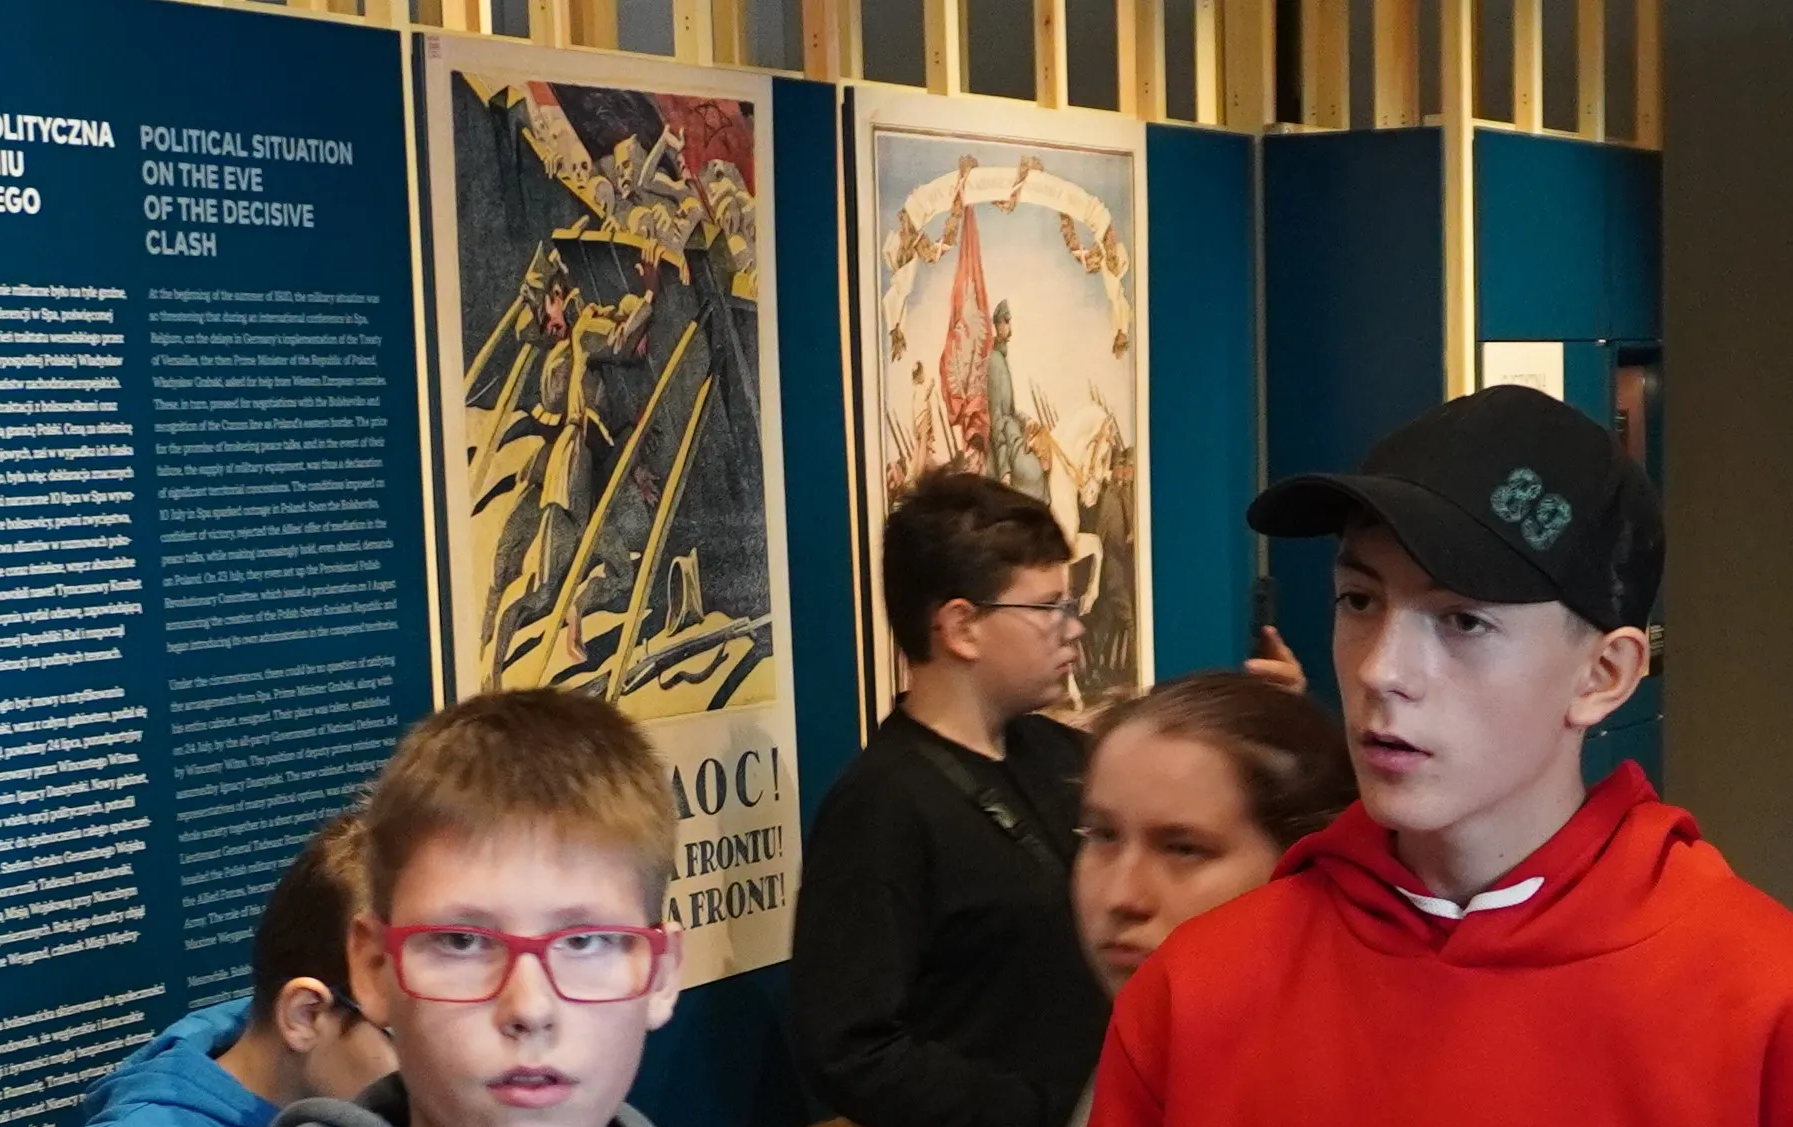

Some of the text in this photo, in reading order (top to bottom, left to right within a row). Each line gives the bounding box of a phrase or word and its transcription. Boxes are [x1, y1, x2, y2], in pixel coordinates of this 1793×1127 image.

[140, 125, 352, 165] POLITICAL SITUATION
[143, 160, 263, 191] ON THE EVE
[144, 195, 314, 227] OF THE DECISIVE
[146, 230, 216, 256] CLASH
[685, 826, 782, 878] FRONTU!
[690, 872, 786, 929] FRONT!
